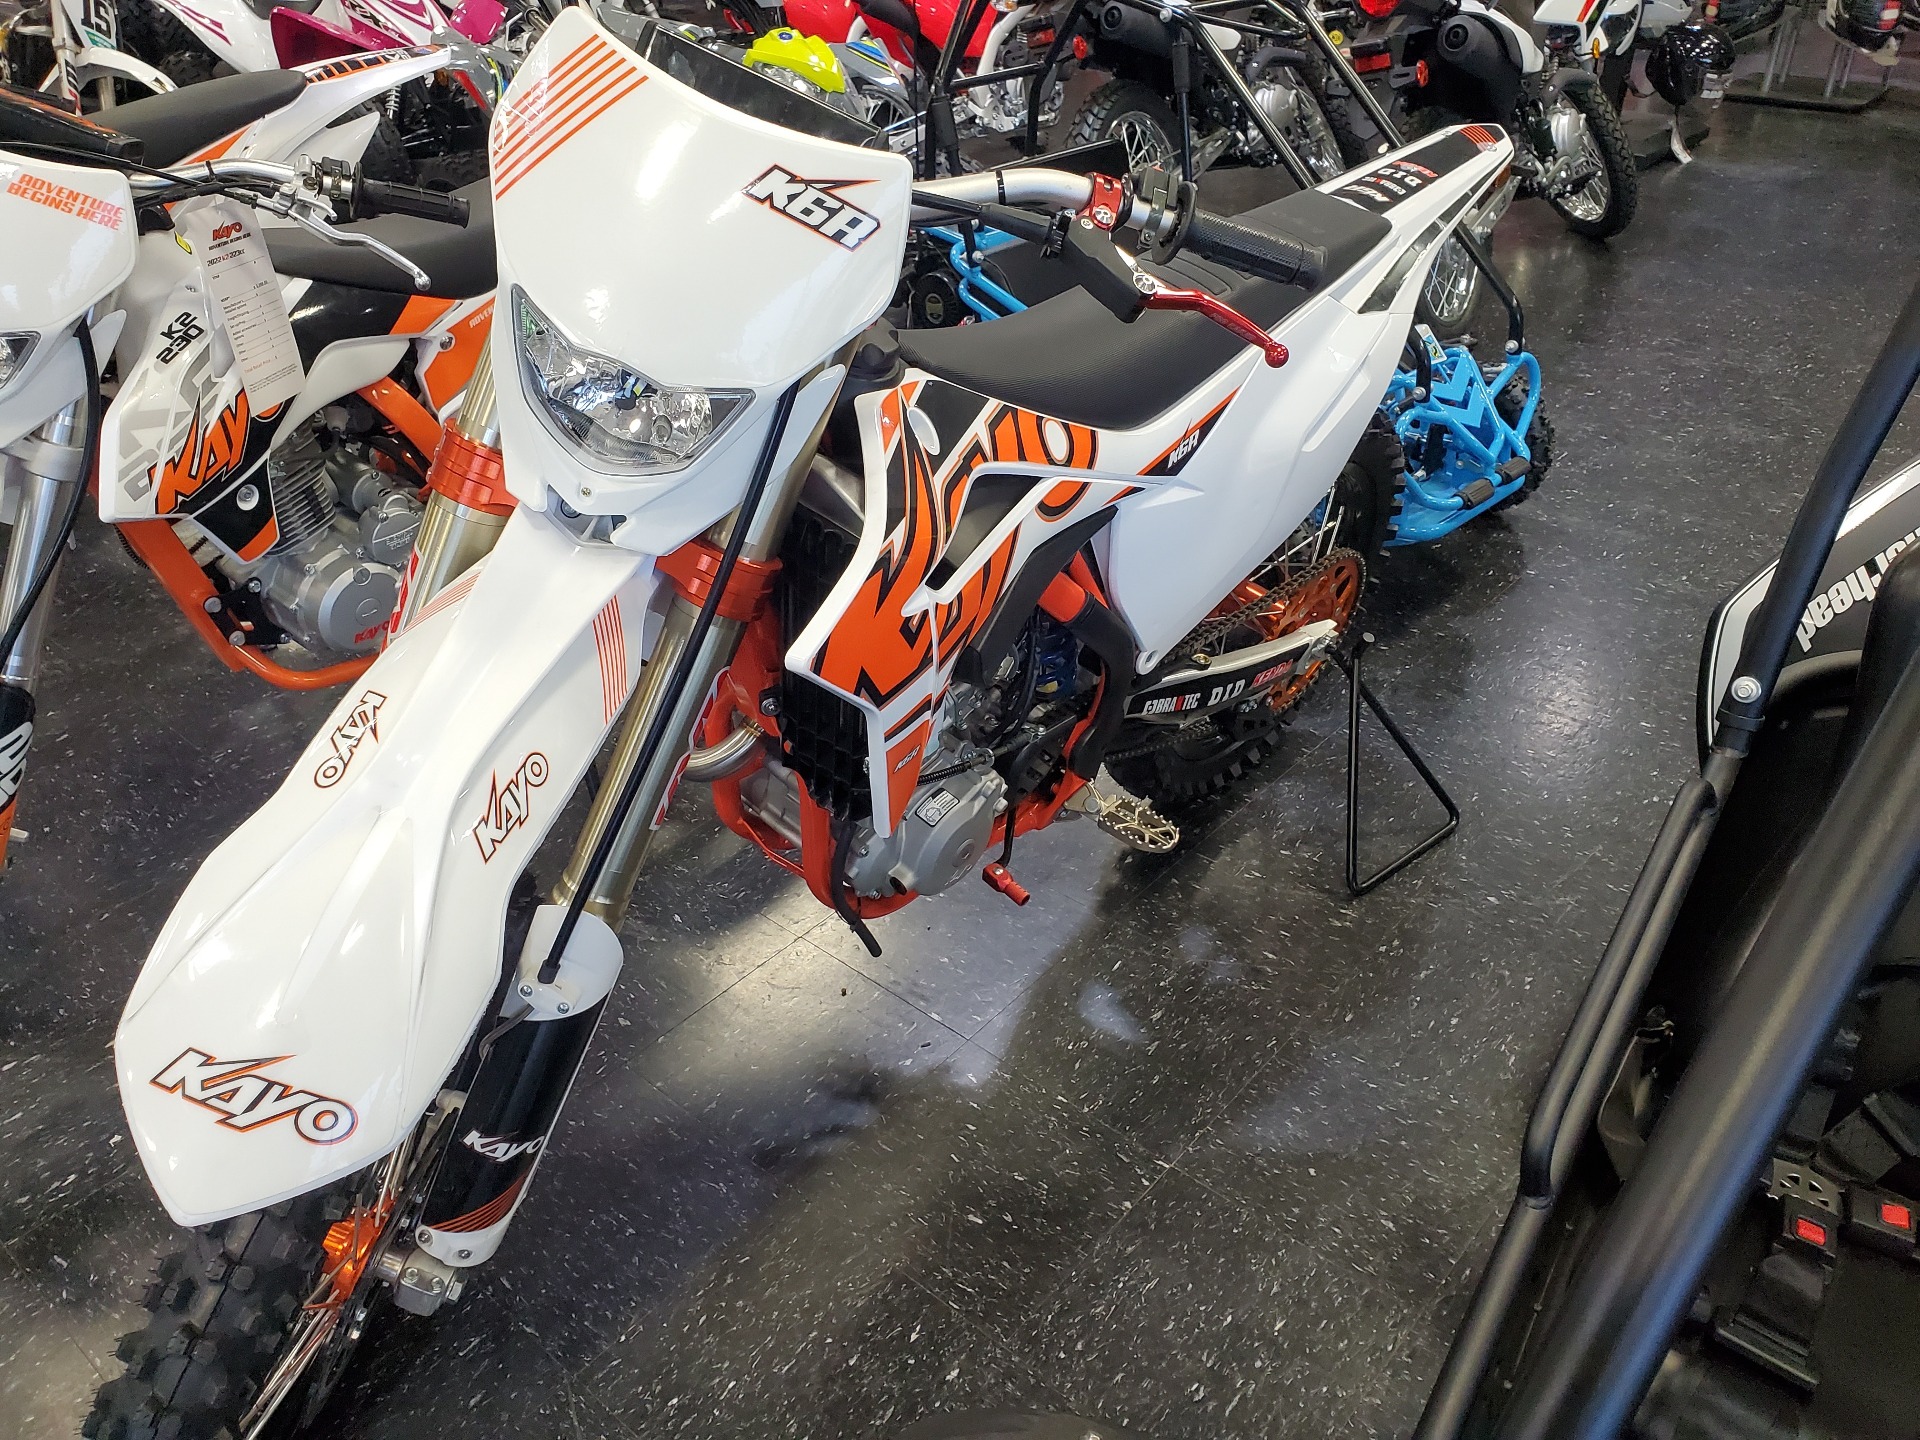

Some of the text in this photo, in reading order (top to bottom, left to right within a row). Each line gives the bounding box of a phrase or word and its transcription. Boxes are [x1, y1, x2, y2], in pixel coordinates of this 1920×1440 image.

[6, 182, 123, 231] BEGINS HERE
[18, 173, 126, 219] ADVENTURE
[741, 163, 882, 252] K6R
[212, 220, 243, 241] KAYO
[206, 256, 222, 267] 2022
[156, 323, 205, 365] 230
[160, 311, 198, 340] K2
[1167, 419, 1200, 468] K6R
[1206, 678, 1246, 707] DID
[314, 689, 387, 788] KAYO
[472, 751, 548, 865] KAYO
[150, 1047, 358, 1146] KAYO
[460, 1128, 546, 1163] KAYO
